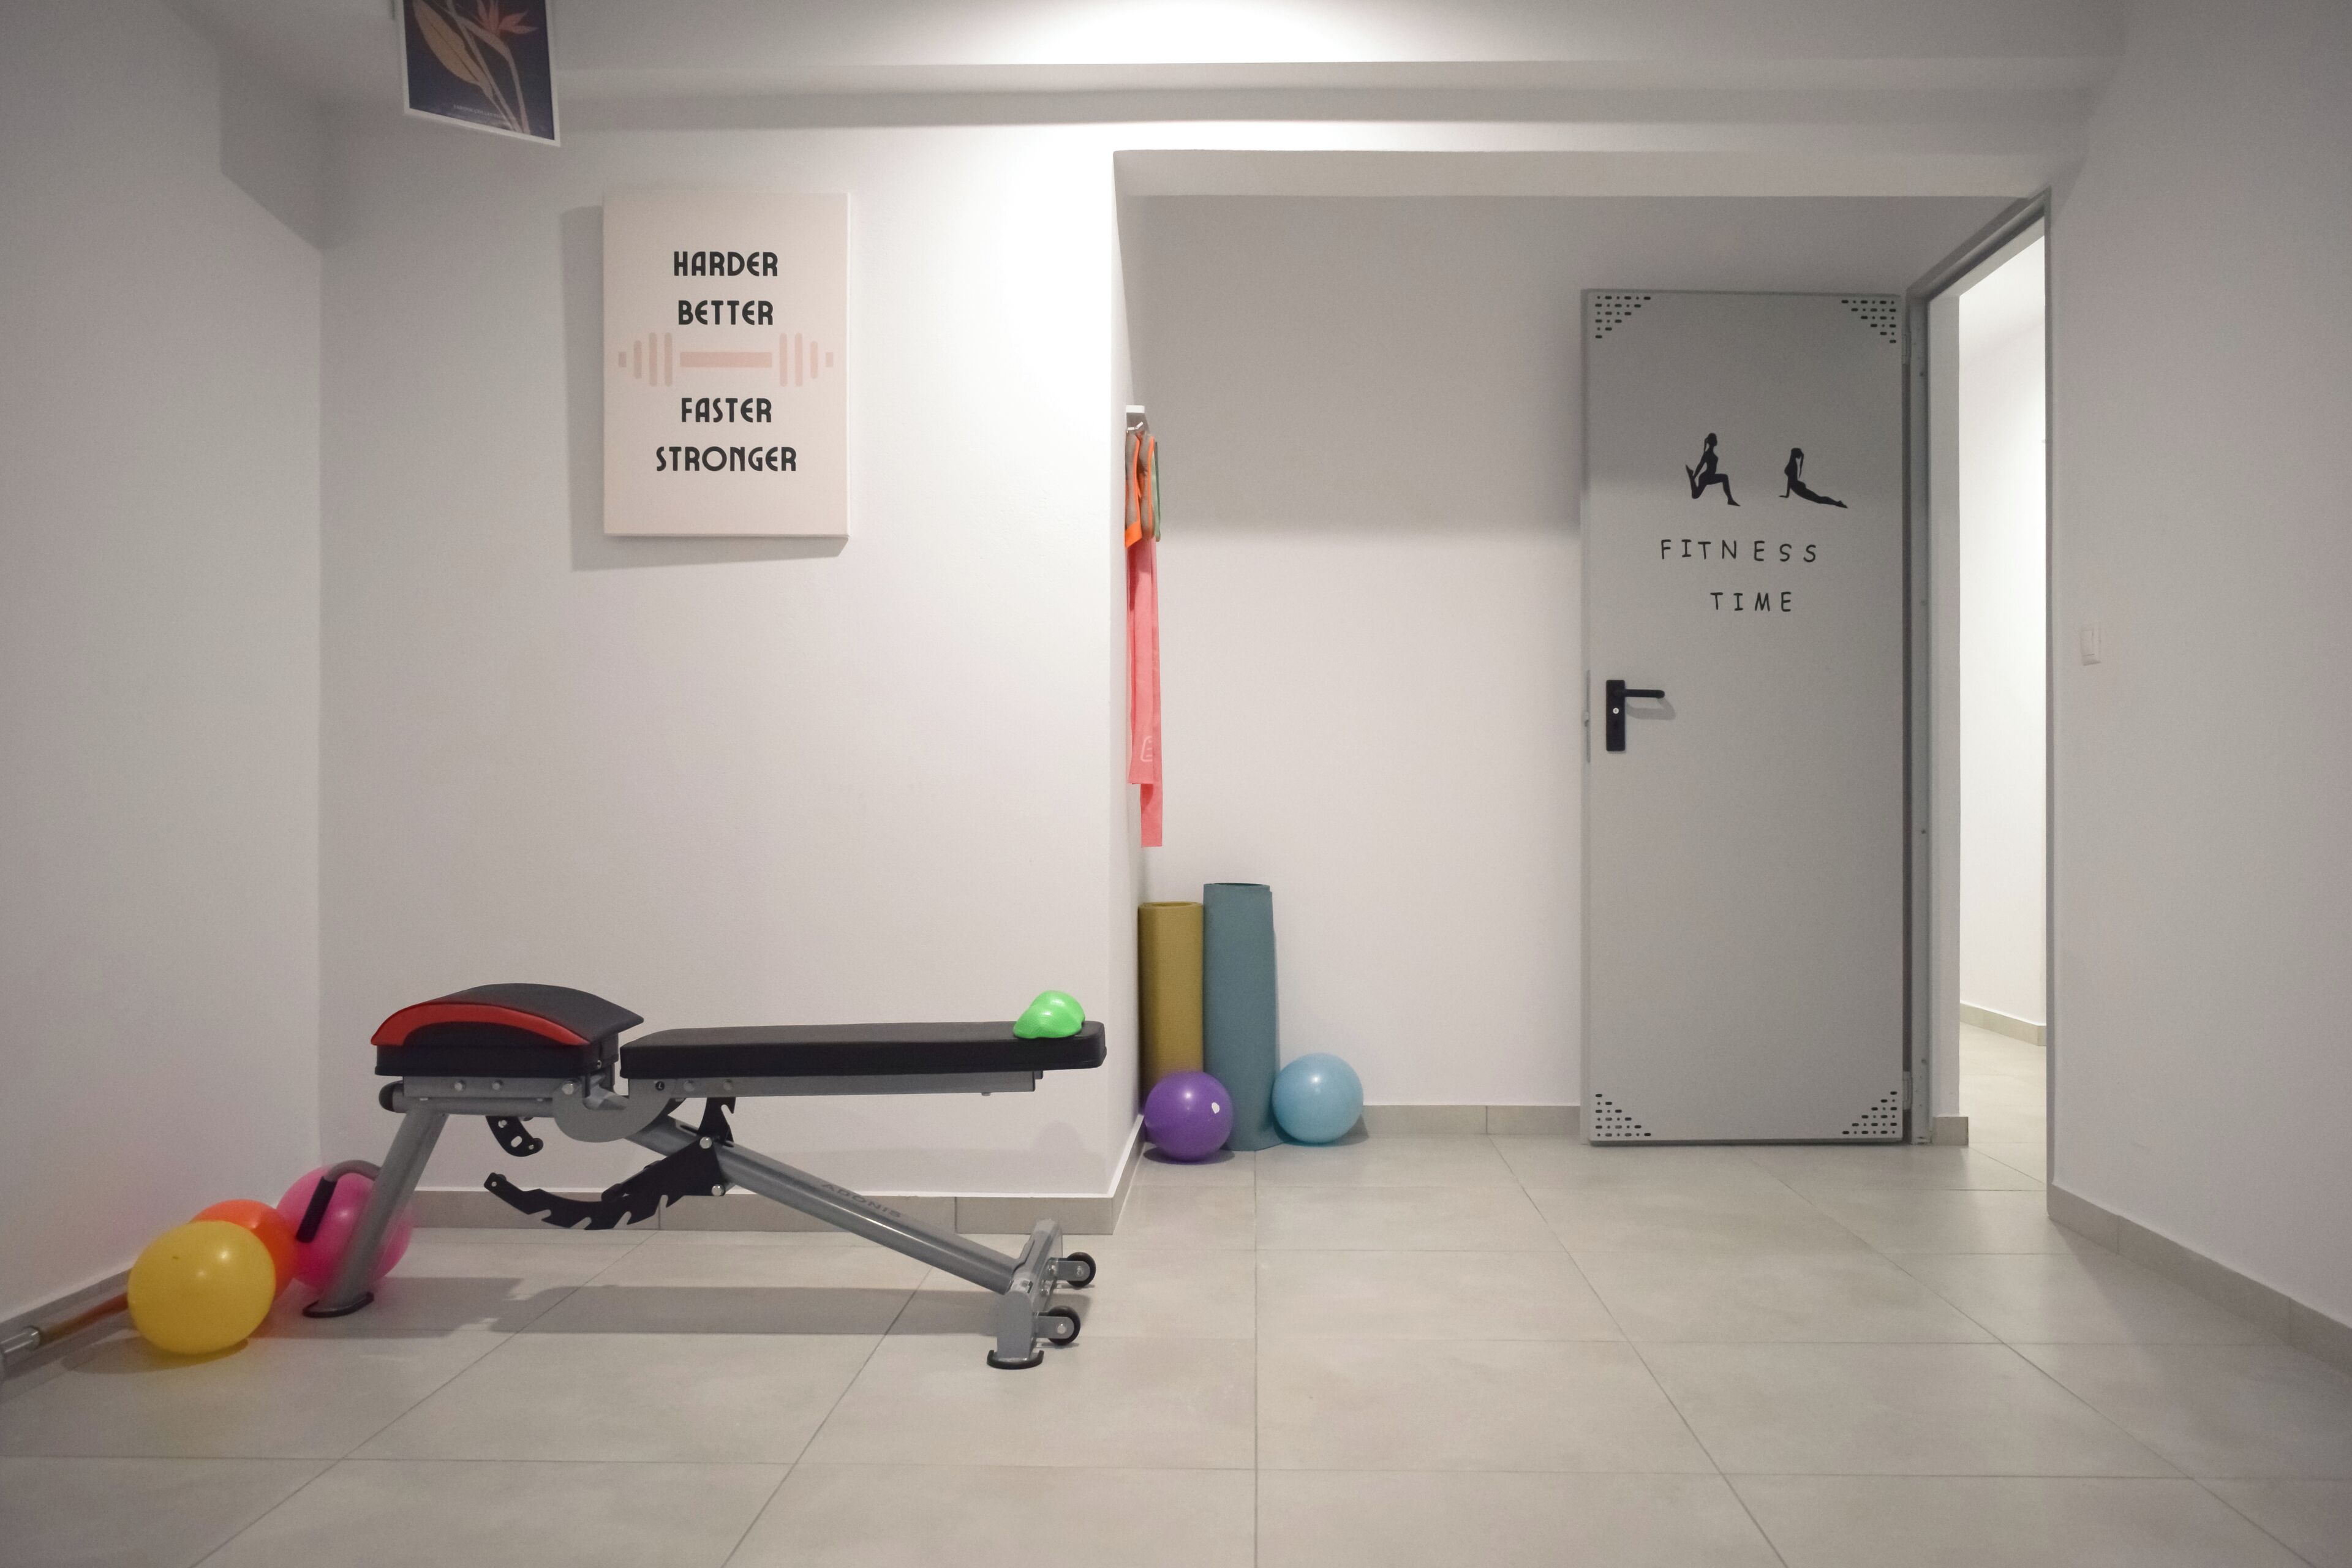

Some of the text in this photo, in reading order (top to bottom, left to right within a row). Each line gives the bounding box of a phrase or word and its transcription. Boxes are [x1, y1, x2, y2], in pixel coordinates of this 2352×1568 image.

[674, 251, 778, 277] HARDER
[678, 300, 774, 325] BETTER
[681, 397, 772, 423] FASTER
[655, 446, 797, 472] STRONGER
[1660, 538, 1817, 563] FITNESS
[1710, 591, 1792, 612] TIME
[821, 1183, 901, 1218] ADONIS
